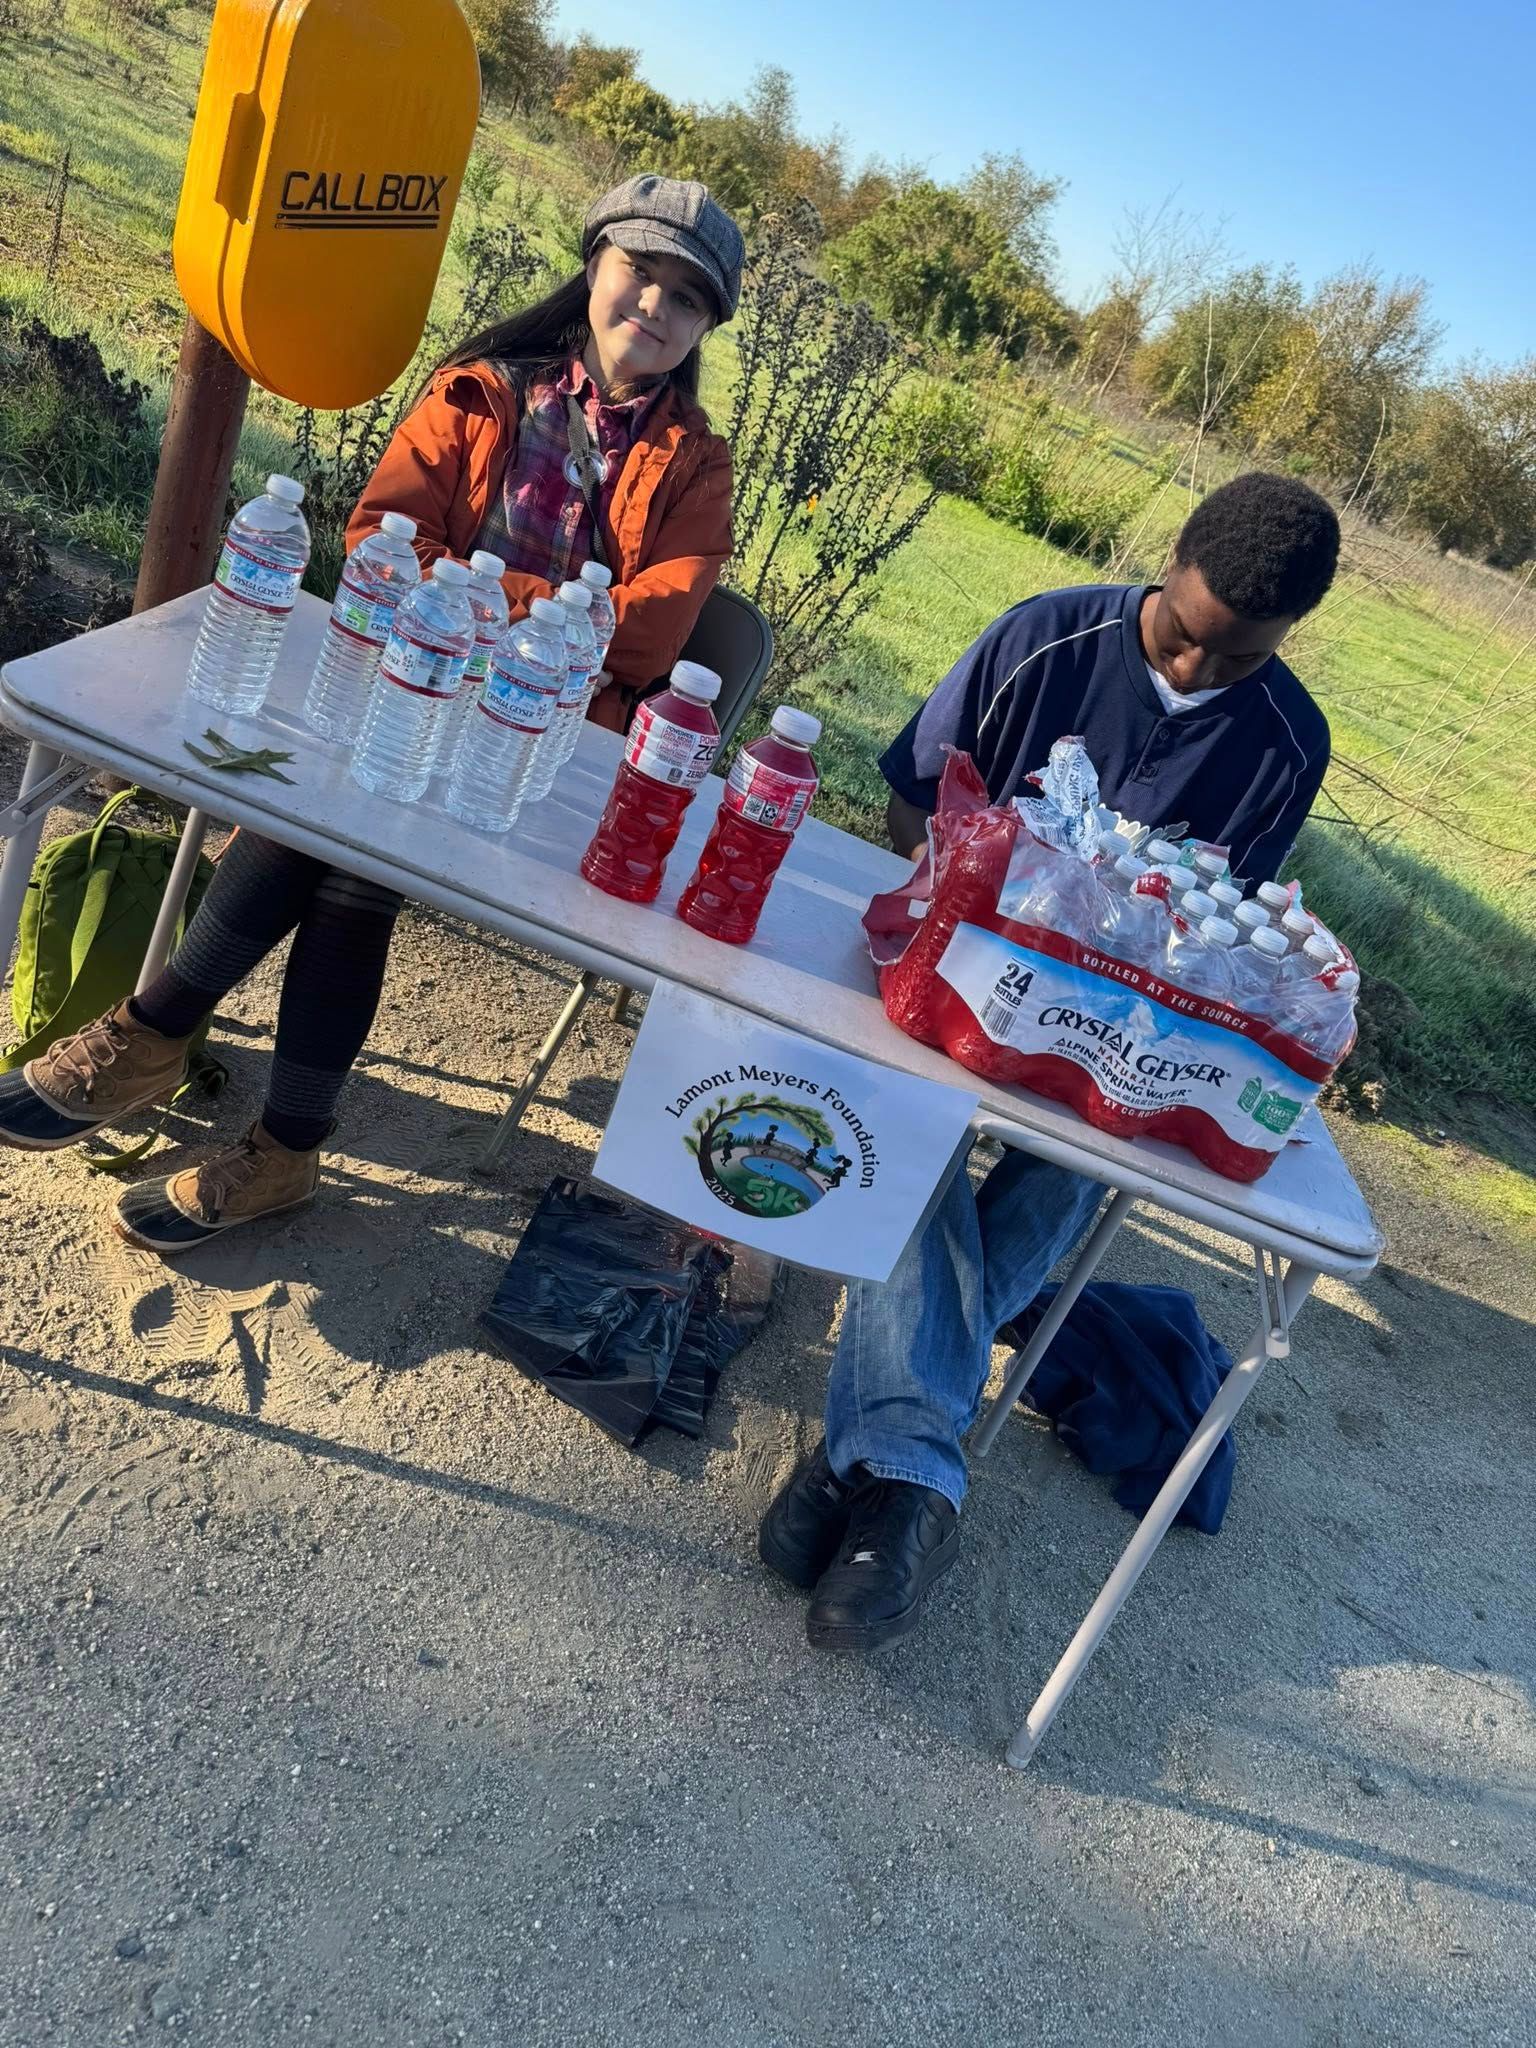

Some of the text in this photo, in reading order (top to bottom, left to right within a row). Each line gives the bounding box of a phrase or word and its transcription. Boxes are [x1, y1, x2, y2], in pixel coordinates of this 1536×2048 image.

[280, 171, 449, 212] CALLBOX
[692, 744, 717, 761] ZE
[994, 982, 1023, 1007] BOTTLES
[998, 962, 1034, 997] 24
[1082, 953, 1249, 1031] BOTTLED AT THE SOURCE
[1038, 1006, 1226, 1088] CRYSTAL GEYSER
[1053, 1037, 1187, 1100] ALPINE SPRING WATER
[1097, 1045, 1155, 1088] NATURAL
[1103, 1097, 1118, 1110] BY
[1121, 1106, 1136, 1117] CG
[665, 1064, 881, 1189] Lamont Meyers Foundation
[705, 1176, 737, 1206] 2025
[742, 1178, 800, 1214] 5K
